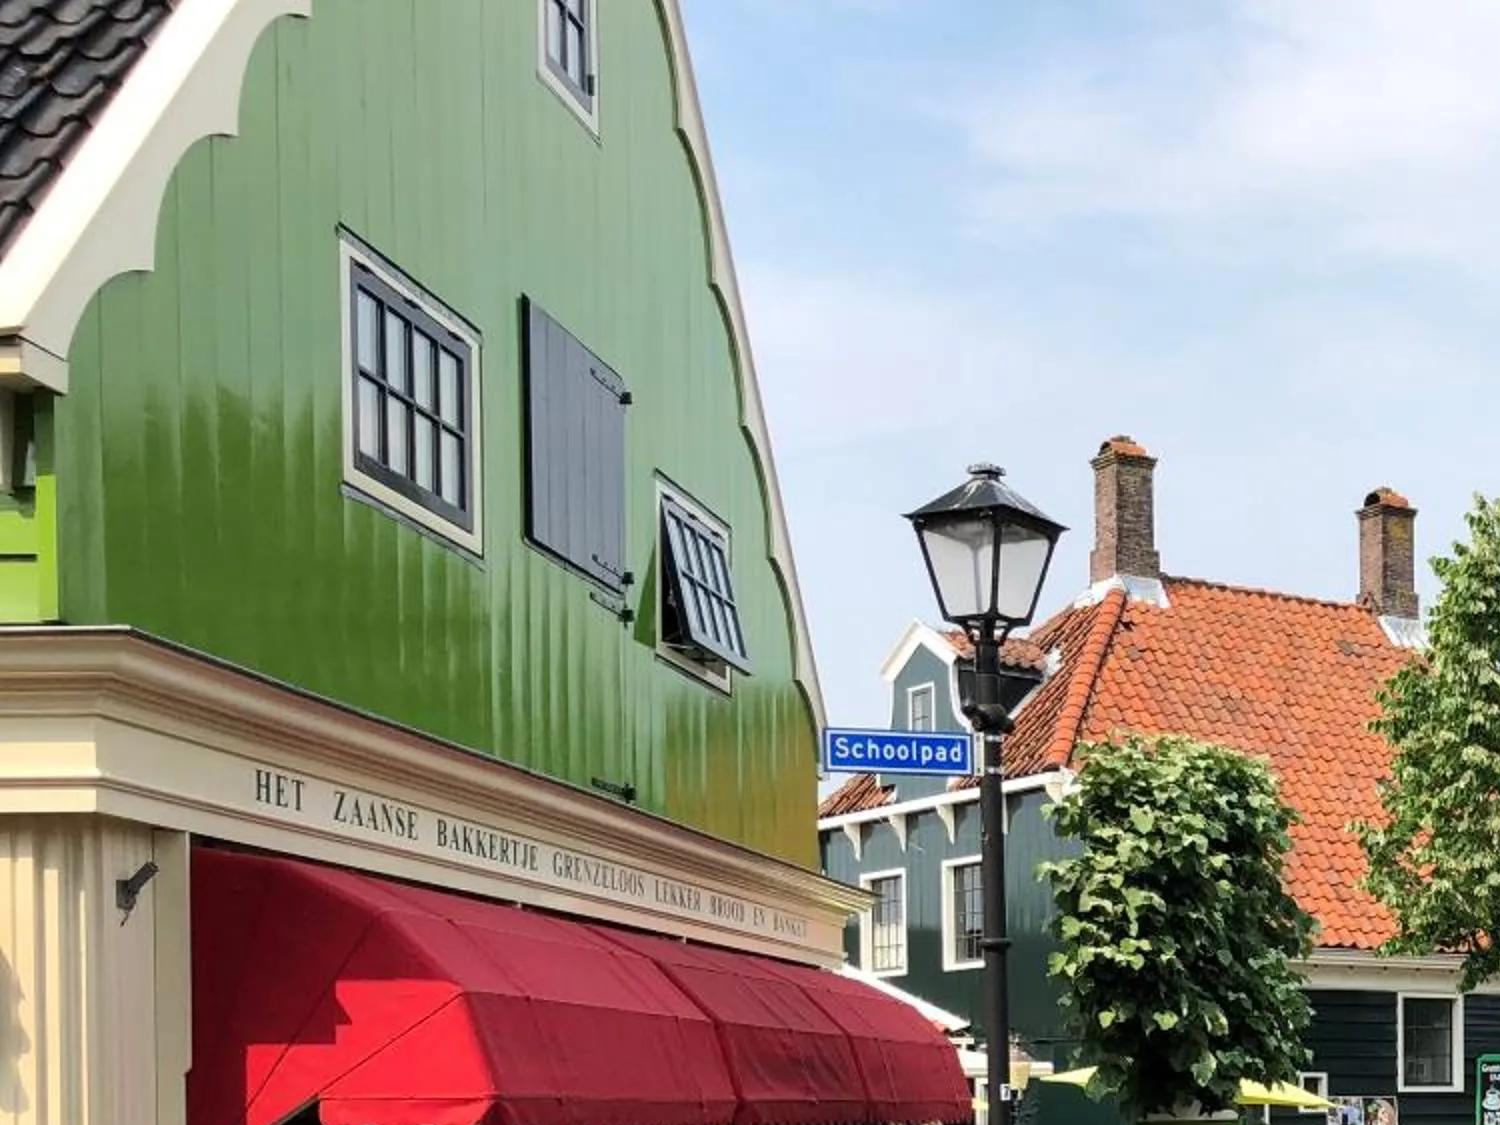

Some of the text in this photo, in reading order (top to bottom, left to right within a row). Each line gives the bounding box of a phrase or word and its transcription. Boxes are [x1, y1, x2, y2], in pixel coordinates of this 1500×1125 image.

[835, 737, 962, 764] Schoolpad
[255, 769, 305, 811] HET
[333, 790, 419, 841] ZAANSE
[437, 818, 538, 872] BAKKERTJE
[552, 851, 645, 897] GRENZELOOS
[655, 879, 702, 911] LEKKER
